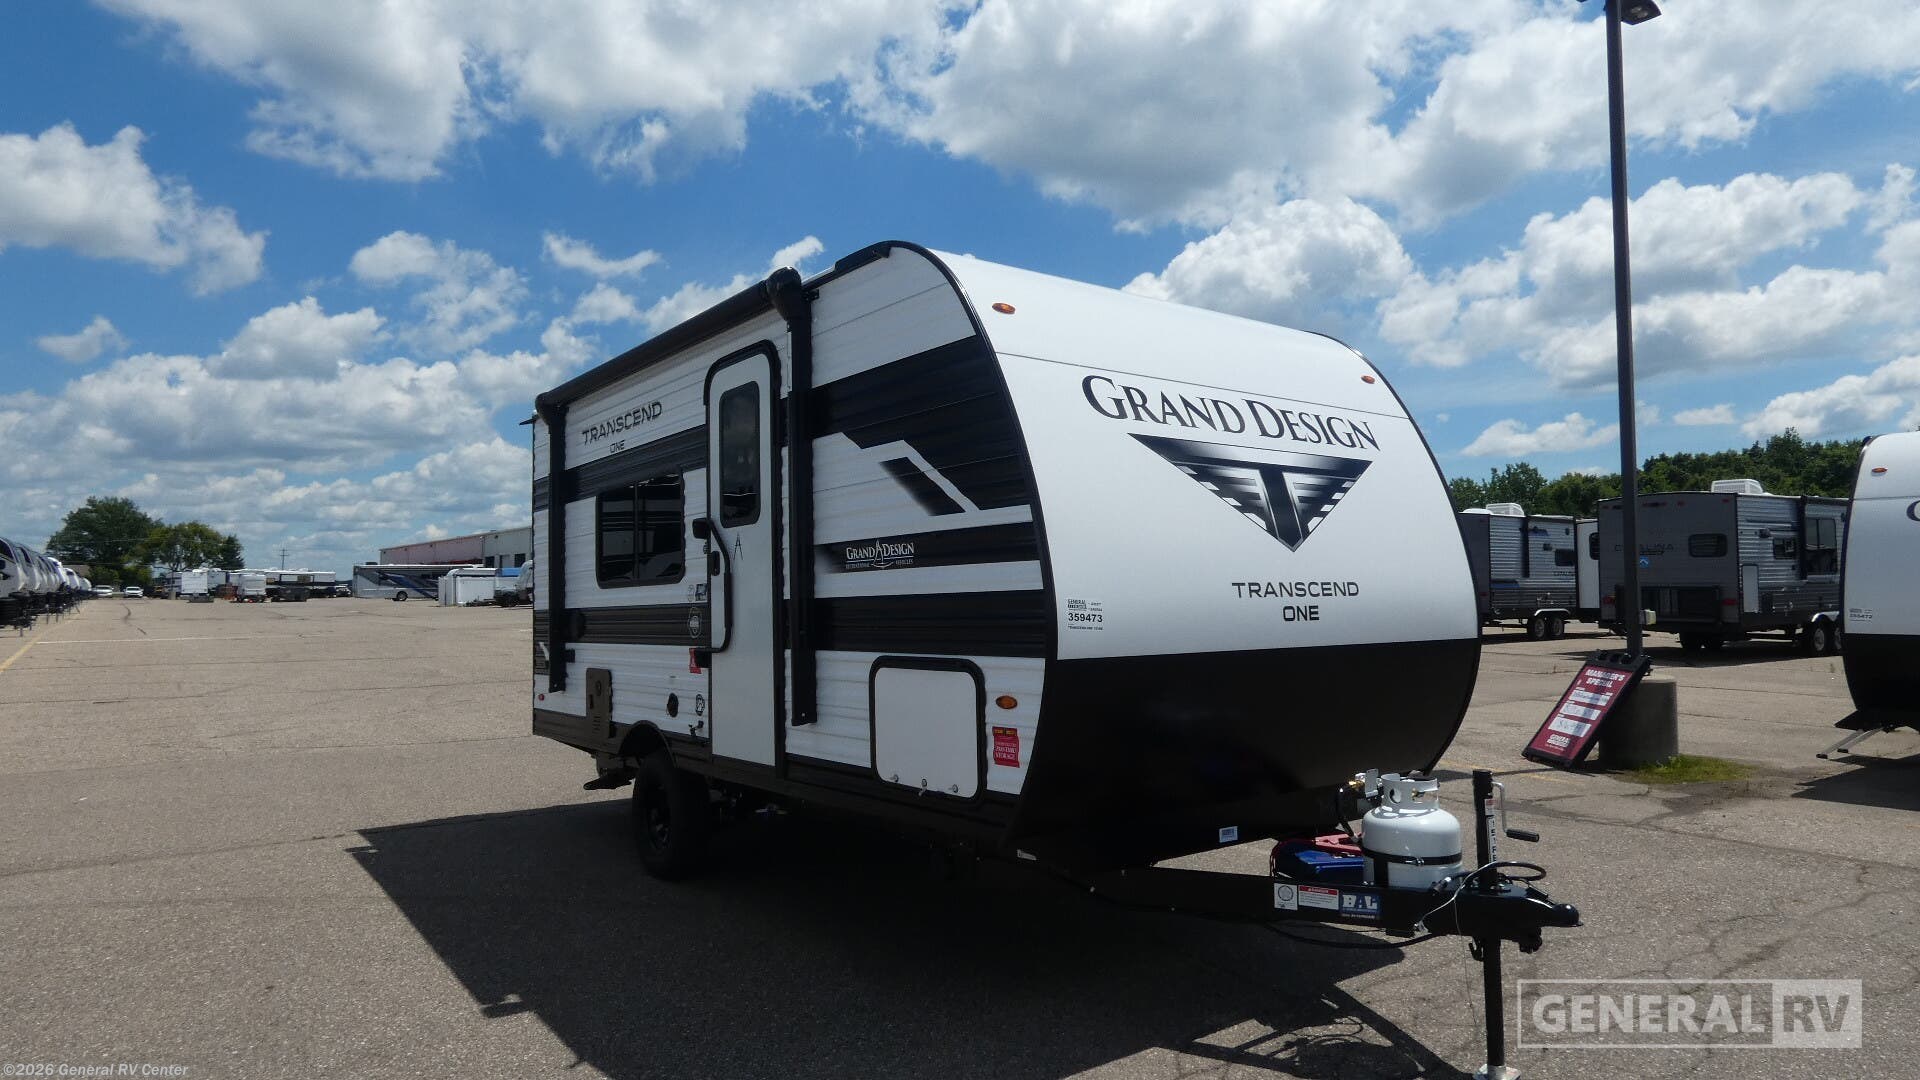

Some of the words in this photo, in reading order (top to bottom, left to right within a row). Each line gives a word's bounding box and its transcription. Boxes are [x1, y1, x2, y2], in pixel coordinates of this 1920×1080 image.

[1081, 375, 1246, 434] GRAND
[1242, 399, 1381, 451] DESIGN
[581, 401, 663, 446] TRANSCEND
[609, 439, 626, 454] ONE
[846, 547, 876, 560] GRAND
[881, 542, 915, 557] DESIGN
[1231, 582, 1360, 599] TRANSCEND
[1067, 612, 1103, 623] 359473
[1282, 605, 1320, 622] ONE
